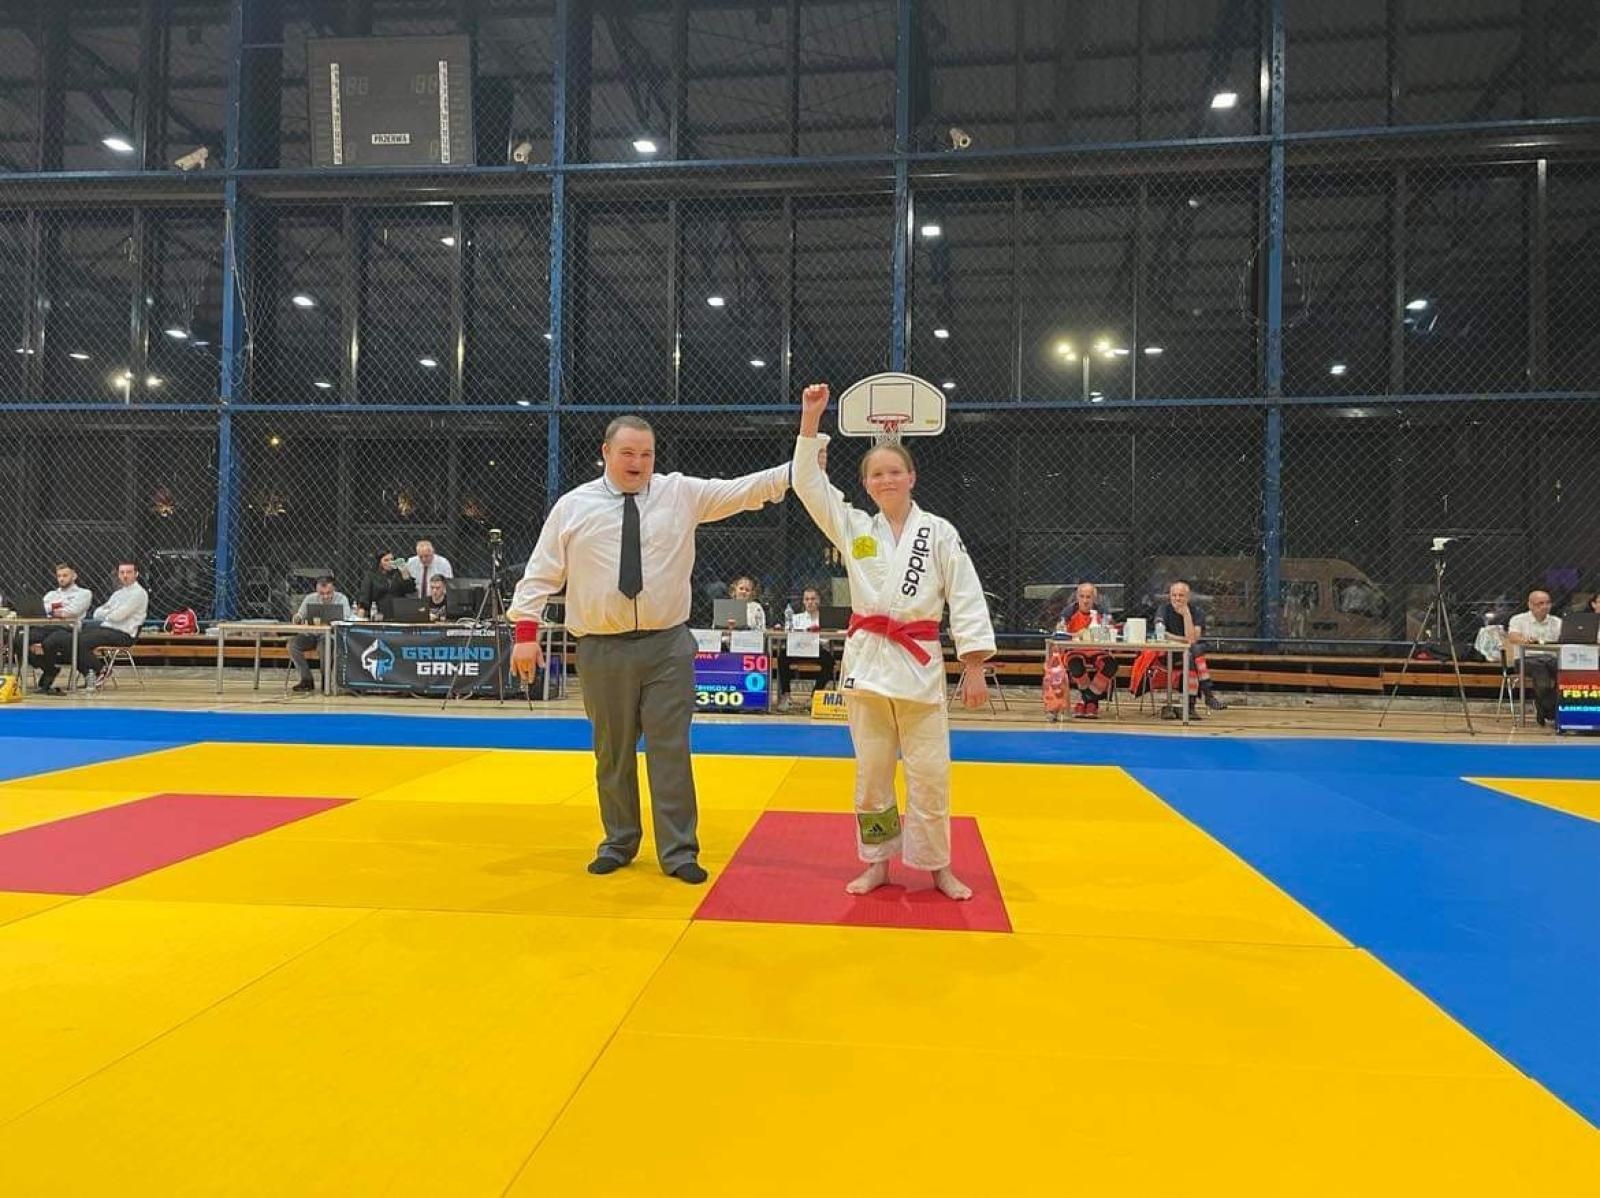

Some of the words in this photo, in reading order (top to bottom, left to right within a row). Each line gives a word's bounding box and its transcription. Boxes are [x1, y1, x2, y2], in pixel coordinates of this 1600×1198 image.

[901, 527, 931, 597] adidas
[402, 646, 495, 660] GROUND
[416, 661, 480, 675] GAME
[743, 654, 768, 671] 50
[744, 672, 766, 691] 0
